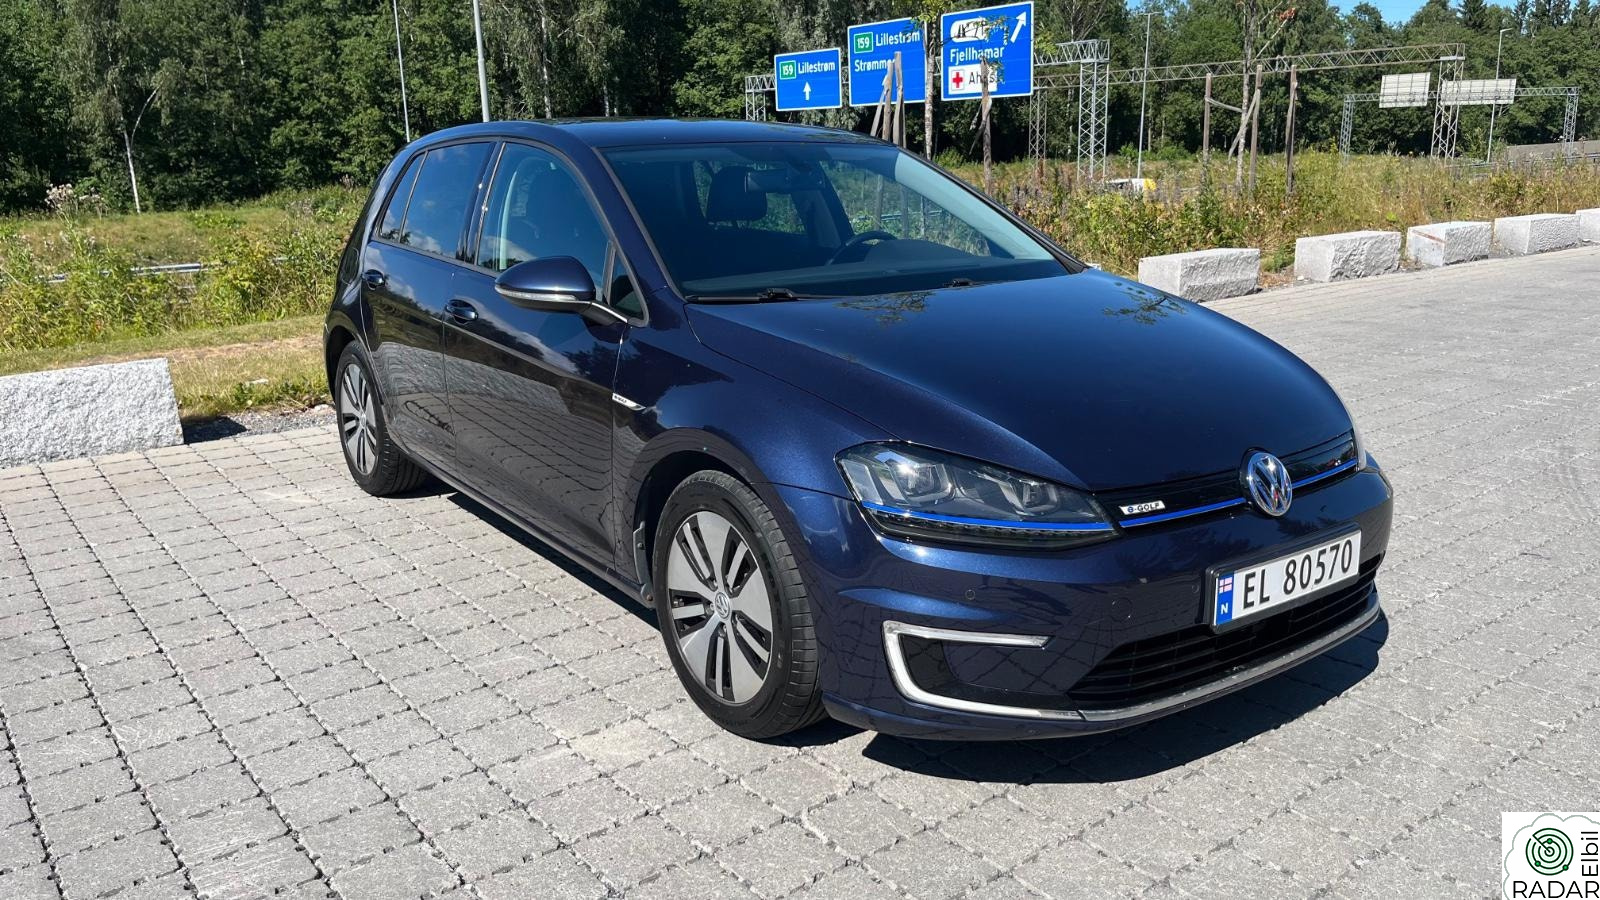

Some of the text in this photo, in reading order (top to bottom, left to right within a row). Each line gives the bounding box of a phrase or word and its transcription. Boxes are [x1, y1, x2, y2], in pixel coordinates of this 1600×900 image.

[857, 31, 920, 49] 159 Lillestrøm
[950, 46, 1005, 66] Fjellhamar
[782, 60, 836, 76] 159 Lillestrøm
[854, 58, 897, 72] Strømm
[1127, 502, 1160, 513] e-GOLF
[1242, 539, 1353, 610] EL 80570
[1220, 602, 1229, 615] N
